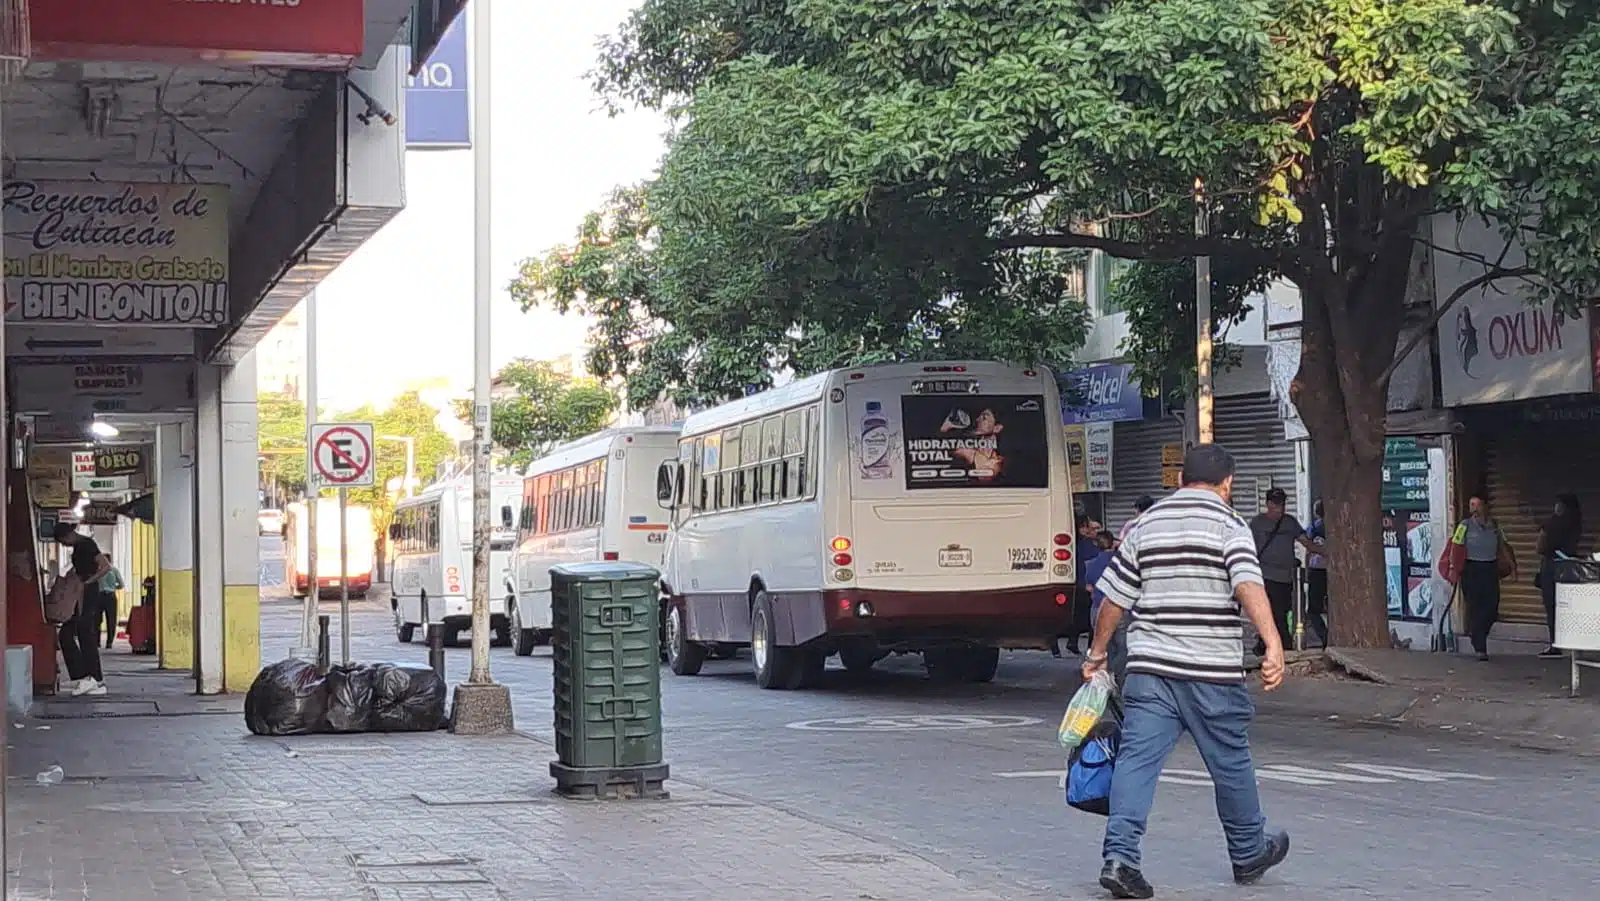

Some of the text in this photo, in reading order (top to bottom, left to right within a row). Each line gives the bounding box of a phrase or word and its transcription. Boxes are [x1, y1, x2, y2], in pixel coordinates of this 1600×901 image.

[4, 181, 208, 217] Recuerdos de
[32, 212, 177, 249] Culiacán
[29, 253, 49, 277] El
[53, 254, 132, 279] Nombre
[136, 255, 225, 280] Grabado
[22, 281, 228, 322] BIEN BONITO!!
[1488, 309, 1562, 360] OXUM
[1088, 367, 1125, 405] telcel
[100, 452, 140, 469] ORO
[332, 439, 354, 470] E
[908, 438, 997, 450] HIDRATACIÓN
[909, 450, 952, 462] TOTAL
